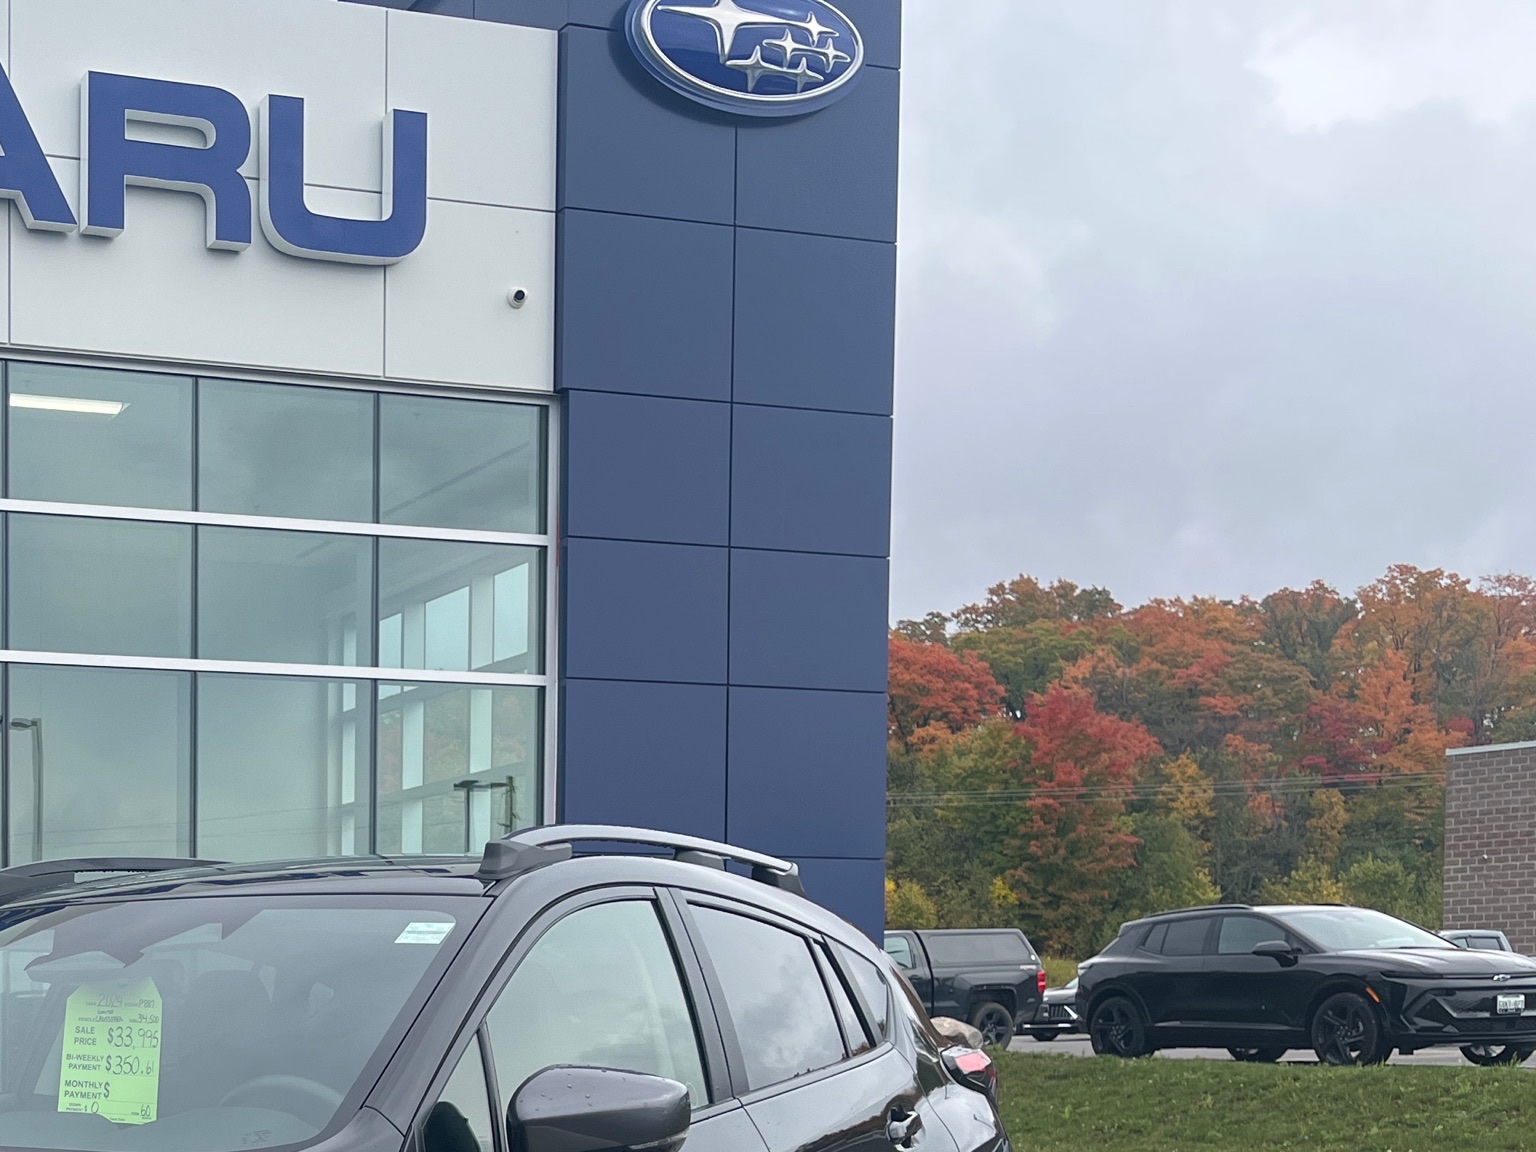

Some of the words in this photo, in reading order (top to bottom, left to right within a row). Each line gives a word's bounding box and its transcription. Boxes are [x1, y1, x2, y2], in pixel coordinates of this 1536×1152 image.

[97, 992, 123, 1008] 2024
[74, 1026, 96, 1035] SALE
[74, 1037, 97, 1046] PRICE
[66, 1054, 104, 1062] BI-WEEKLY
[68, 1062, 101, 1071] PAYMENT
[64, 1079, 103, 1089] MONTHLY
[64, 1090, 102, 1100] PAYMENT
